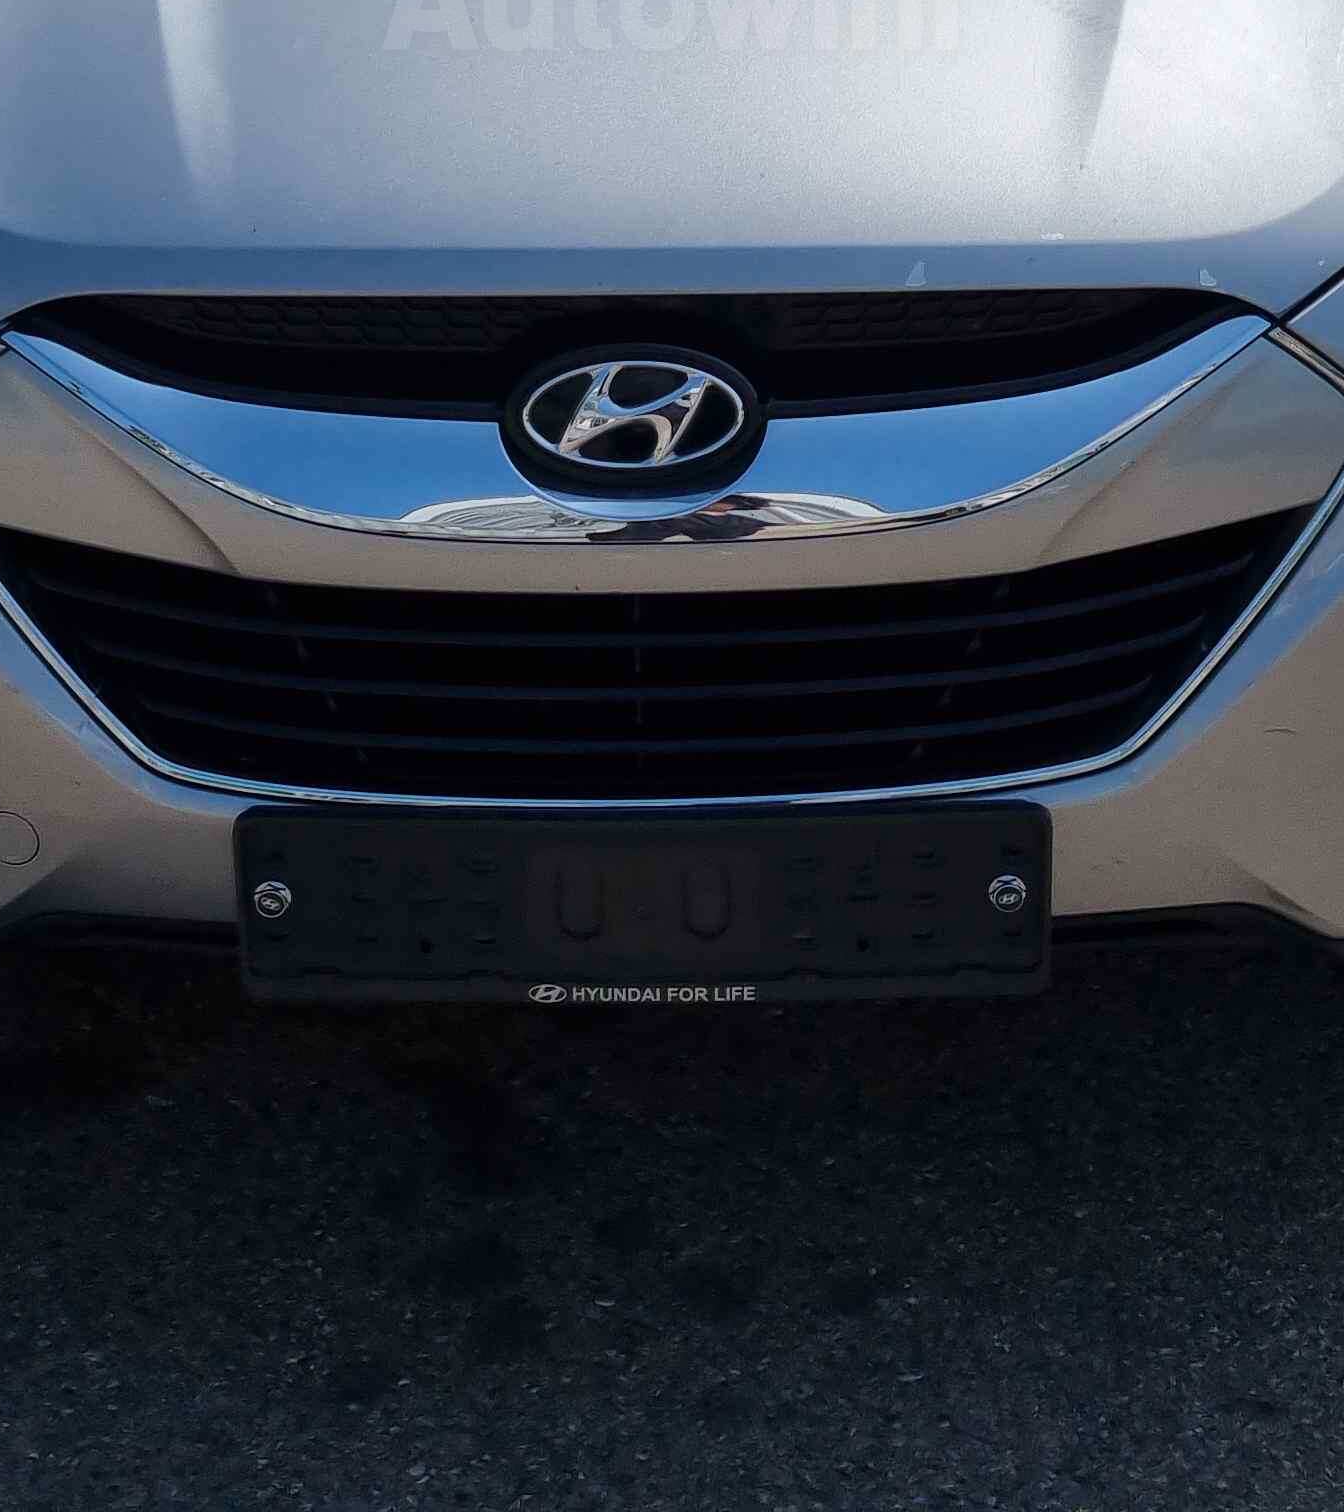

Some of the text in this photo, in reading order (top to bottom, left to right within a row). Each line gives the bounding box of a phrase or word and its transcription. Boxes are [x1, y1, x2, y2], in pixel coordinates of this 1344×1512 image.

[572, 986, 756, 1002] HYUNDAI FOR LIFE
